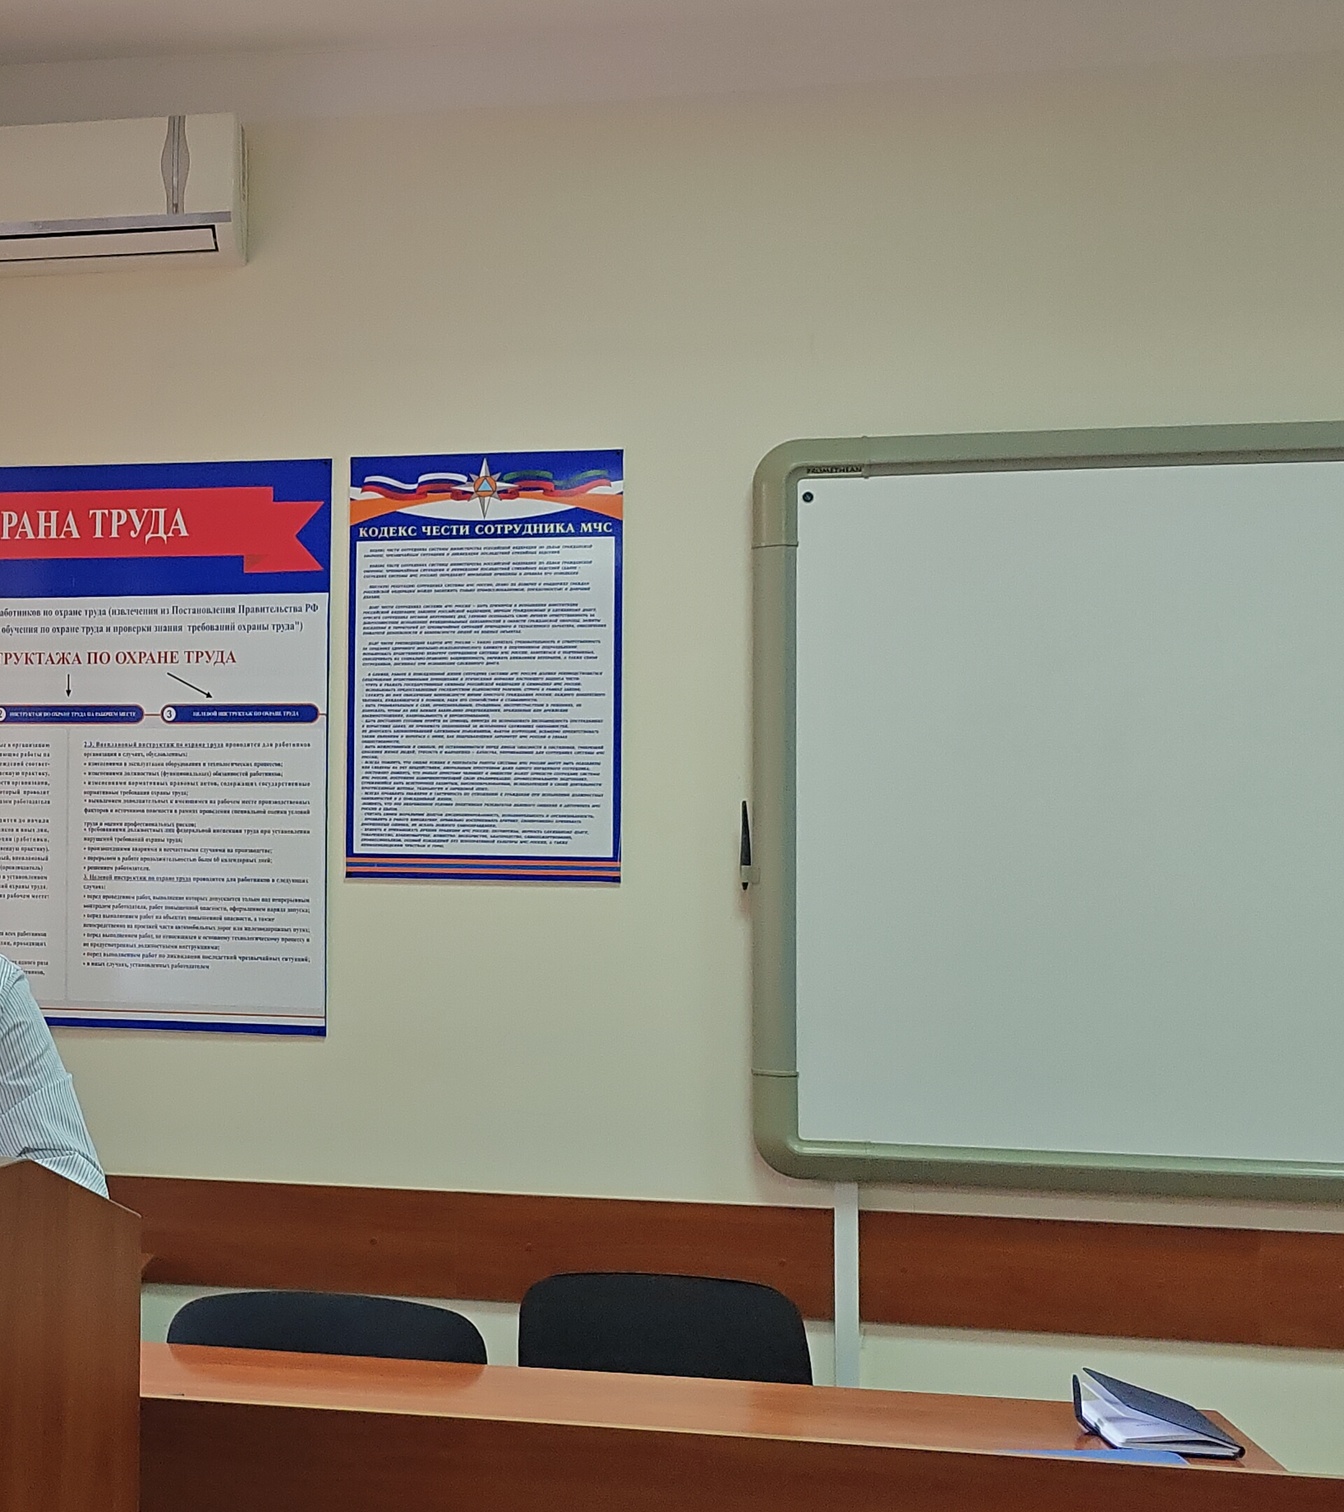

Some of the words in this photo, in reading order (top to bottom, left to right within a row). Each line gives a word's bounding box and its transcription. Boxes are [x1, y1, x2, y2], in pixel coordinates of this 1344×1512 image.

[89, 508, 189, 544] ТРУДА
[358, 525, 417, 538] КОДЕКС
[421, 524, 470, 536] ЧЕСТИ
[474, 522, 575, 537] СОТРУДНИКА
[580, 521, 614, 534] МЧС
[54, 609, 82, 618] охране
[84, 609, 106, 618] труда
[171, 604, 235, 614] Постановления
[238, 603, 302, 615] Правительства
[305, 603, 318, 612] РФ
[1, 624, 38, 636] обучения
[51, 626, 79, 635] охране
[81, 626, 103, 635] труда
[113, 625, 151, 635] проверки
[188, 621, 235, 634] требований
[237, 623, 269, 633] охраны
[87, 651, 110, 664] ПО
[115, 650, 179, 664] ОХРАНЕ
[183, 650, 236, 667] ТРУДА
